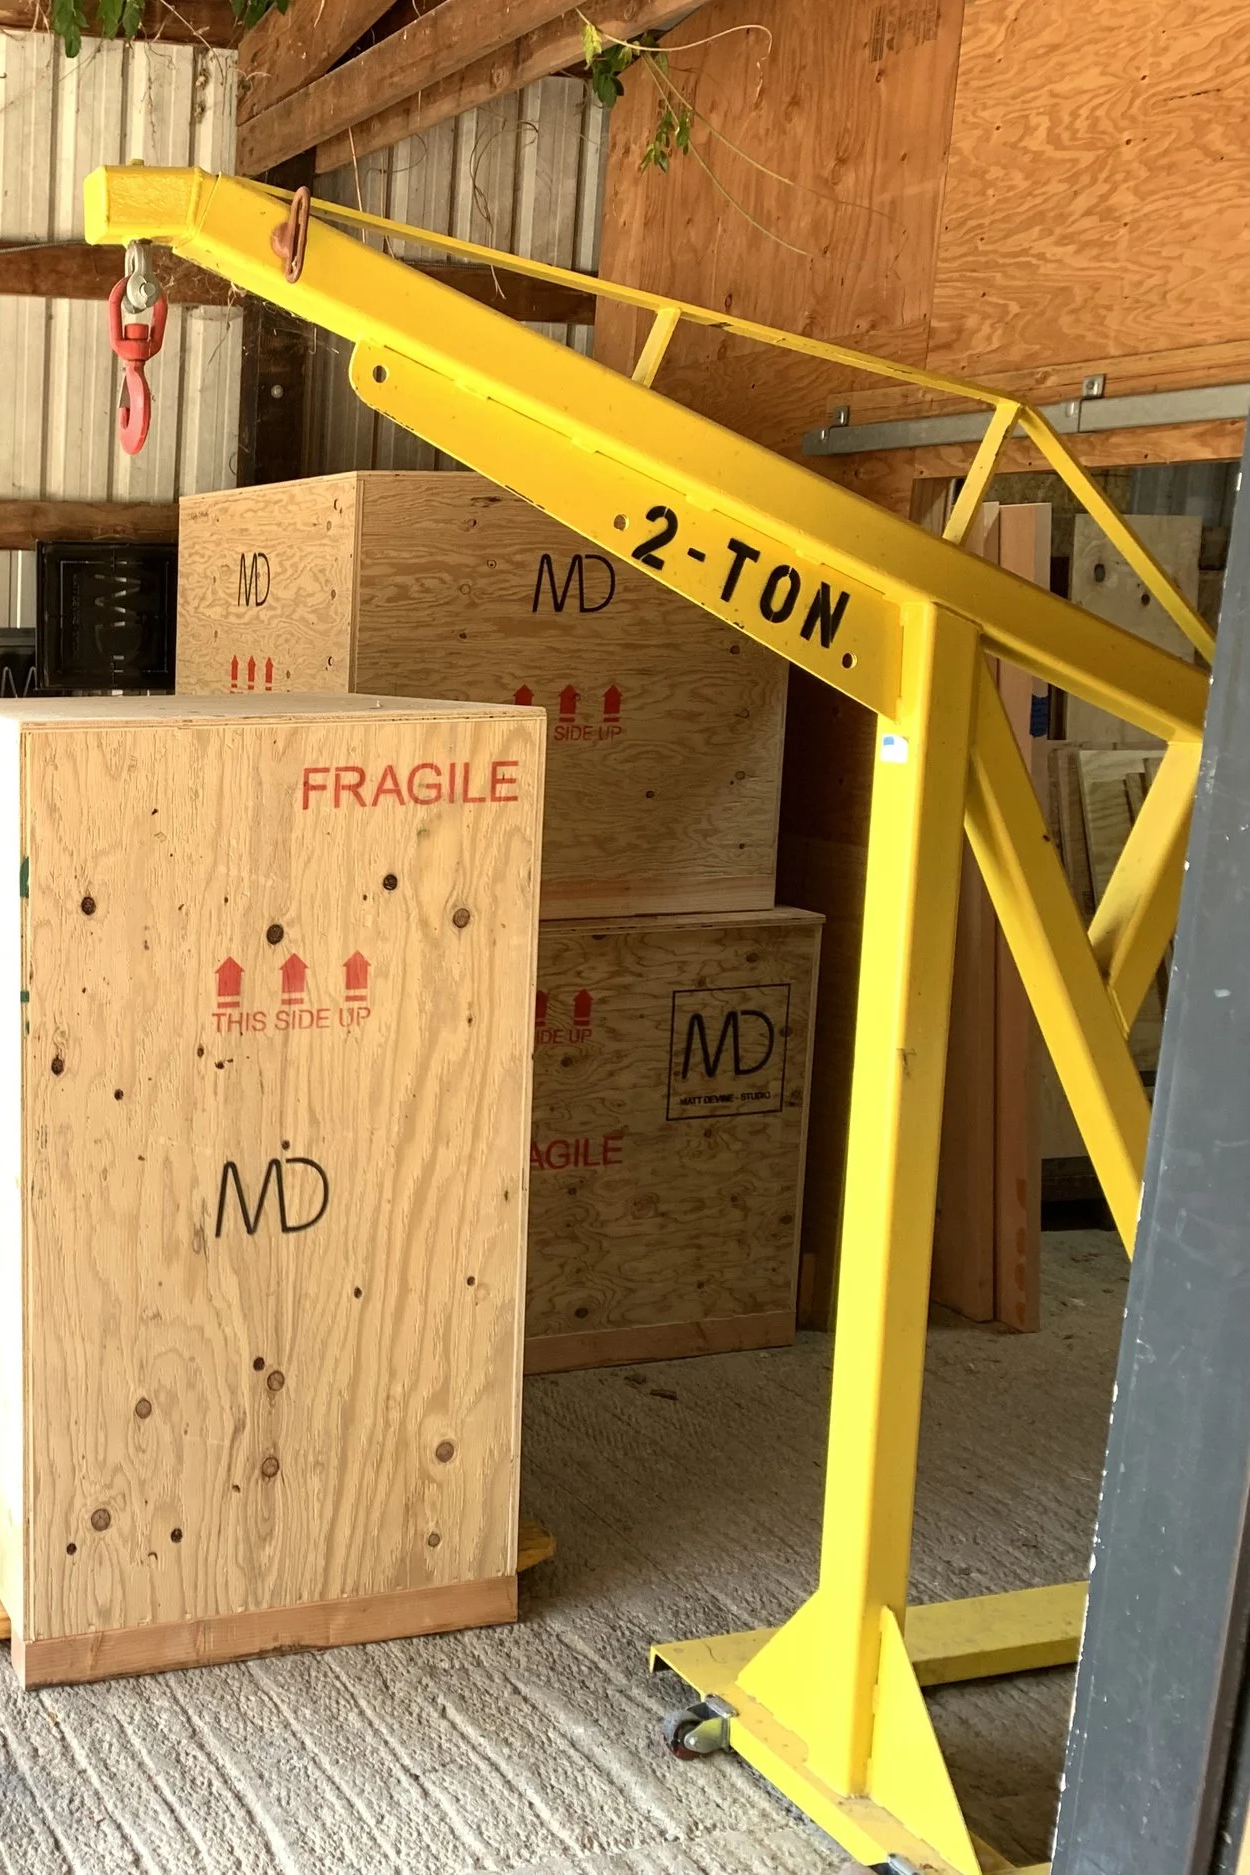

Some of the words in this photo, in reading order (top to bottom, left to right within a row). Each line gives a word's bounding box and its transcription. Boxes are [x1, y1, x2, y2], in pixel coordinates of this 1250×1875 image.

[237, 552, 271, 607] MD
[532, 553, 616, 613] MD
[631, 505, 851, 649] 2-TON
[553, 725, 593, 741] SIDE
[598, 725, 622, 741] UP
[302, 760, 520, 811] FRAGILE
[212, 1010, 267, 1034] THIS
[274, 1008, 331, 1031] SIDE
[338, 1006, 371, 1028] UP
[533, 1028, 564, 1045] IDE
[569, 1027, 592, 1044] UP
[681, 1010, 775, 1080] MD
[740, 1091, 771, 1101] STUDIO
[530, 1132, 624, 1171] AGILE
[215, 1157, 329, 1238] MD
